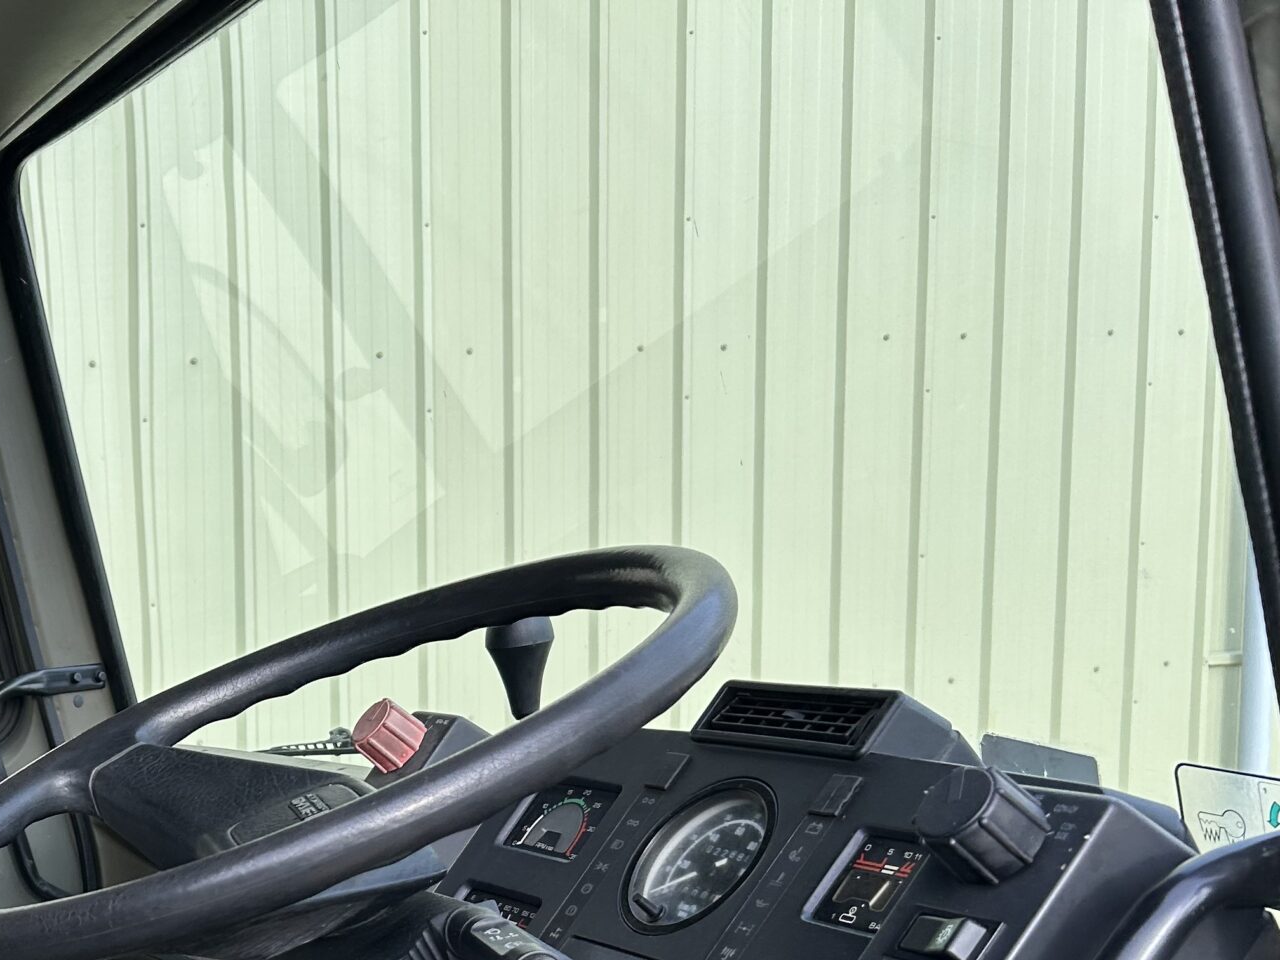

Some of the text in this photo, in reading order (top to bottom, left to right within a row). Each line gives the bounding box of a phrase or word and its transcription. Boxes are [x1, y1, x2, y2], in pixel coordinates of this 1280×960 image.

[864, 843, 922, 861] 0 5 10 11
[868, 921, 881, 930] BA
